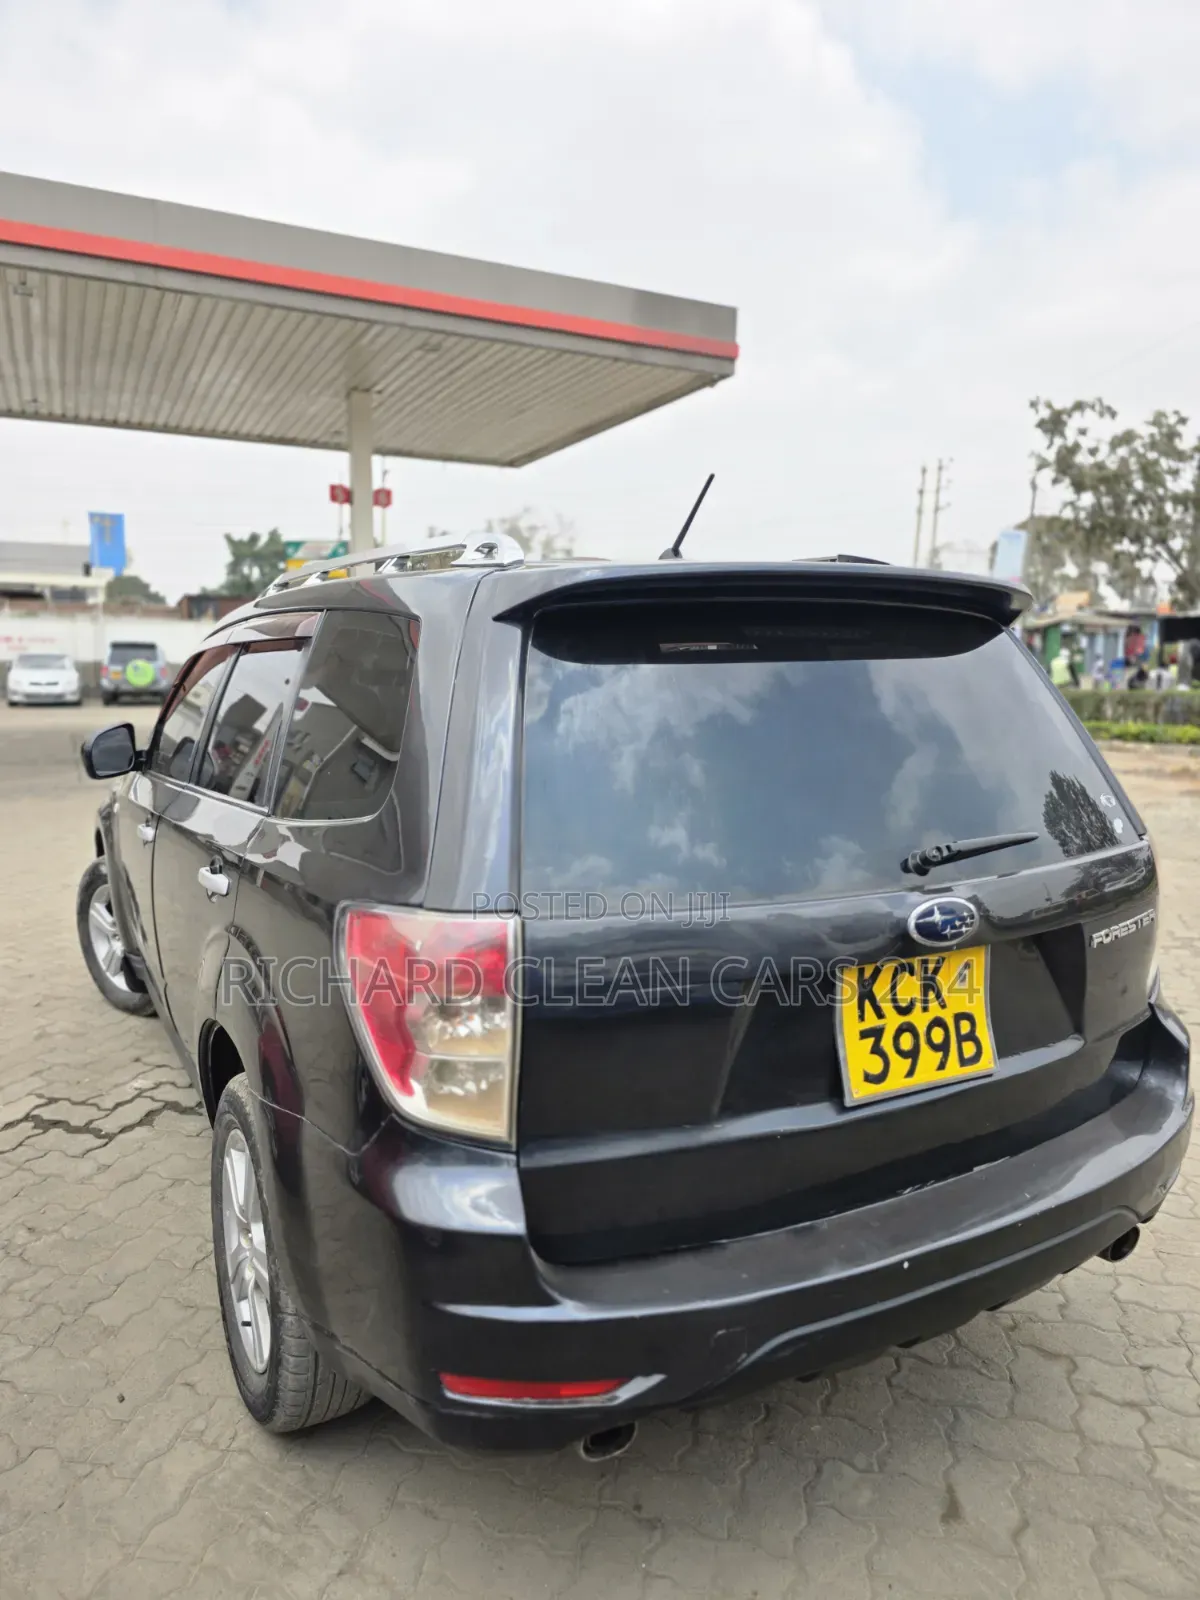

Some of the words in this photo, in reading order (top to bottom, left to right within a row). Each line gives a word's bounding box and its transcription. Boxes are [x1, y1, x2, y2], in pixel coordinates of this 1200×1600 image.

[1090, 908, 1156, 949] FORESTER
[857, 956, 947, 1023] KCK
[859, 1011, 983, 1085] 399B
